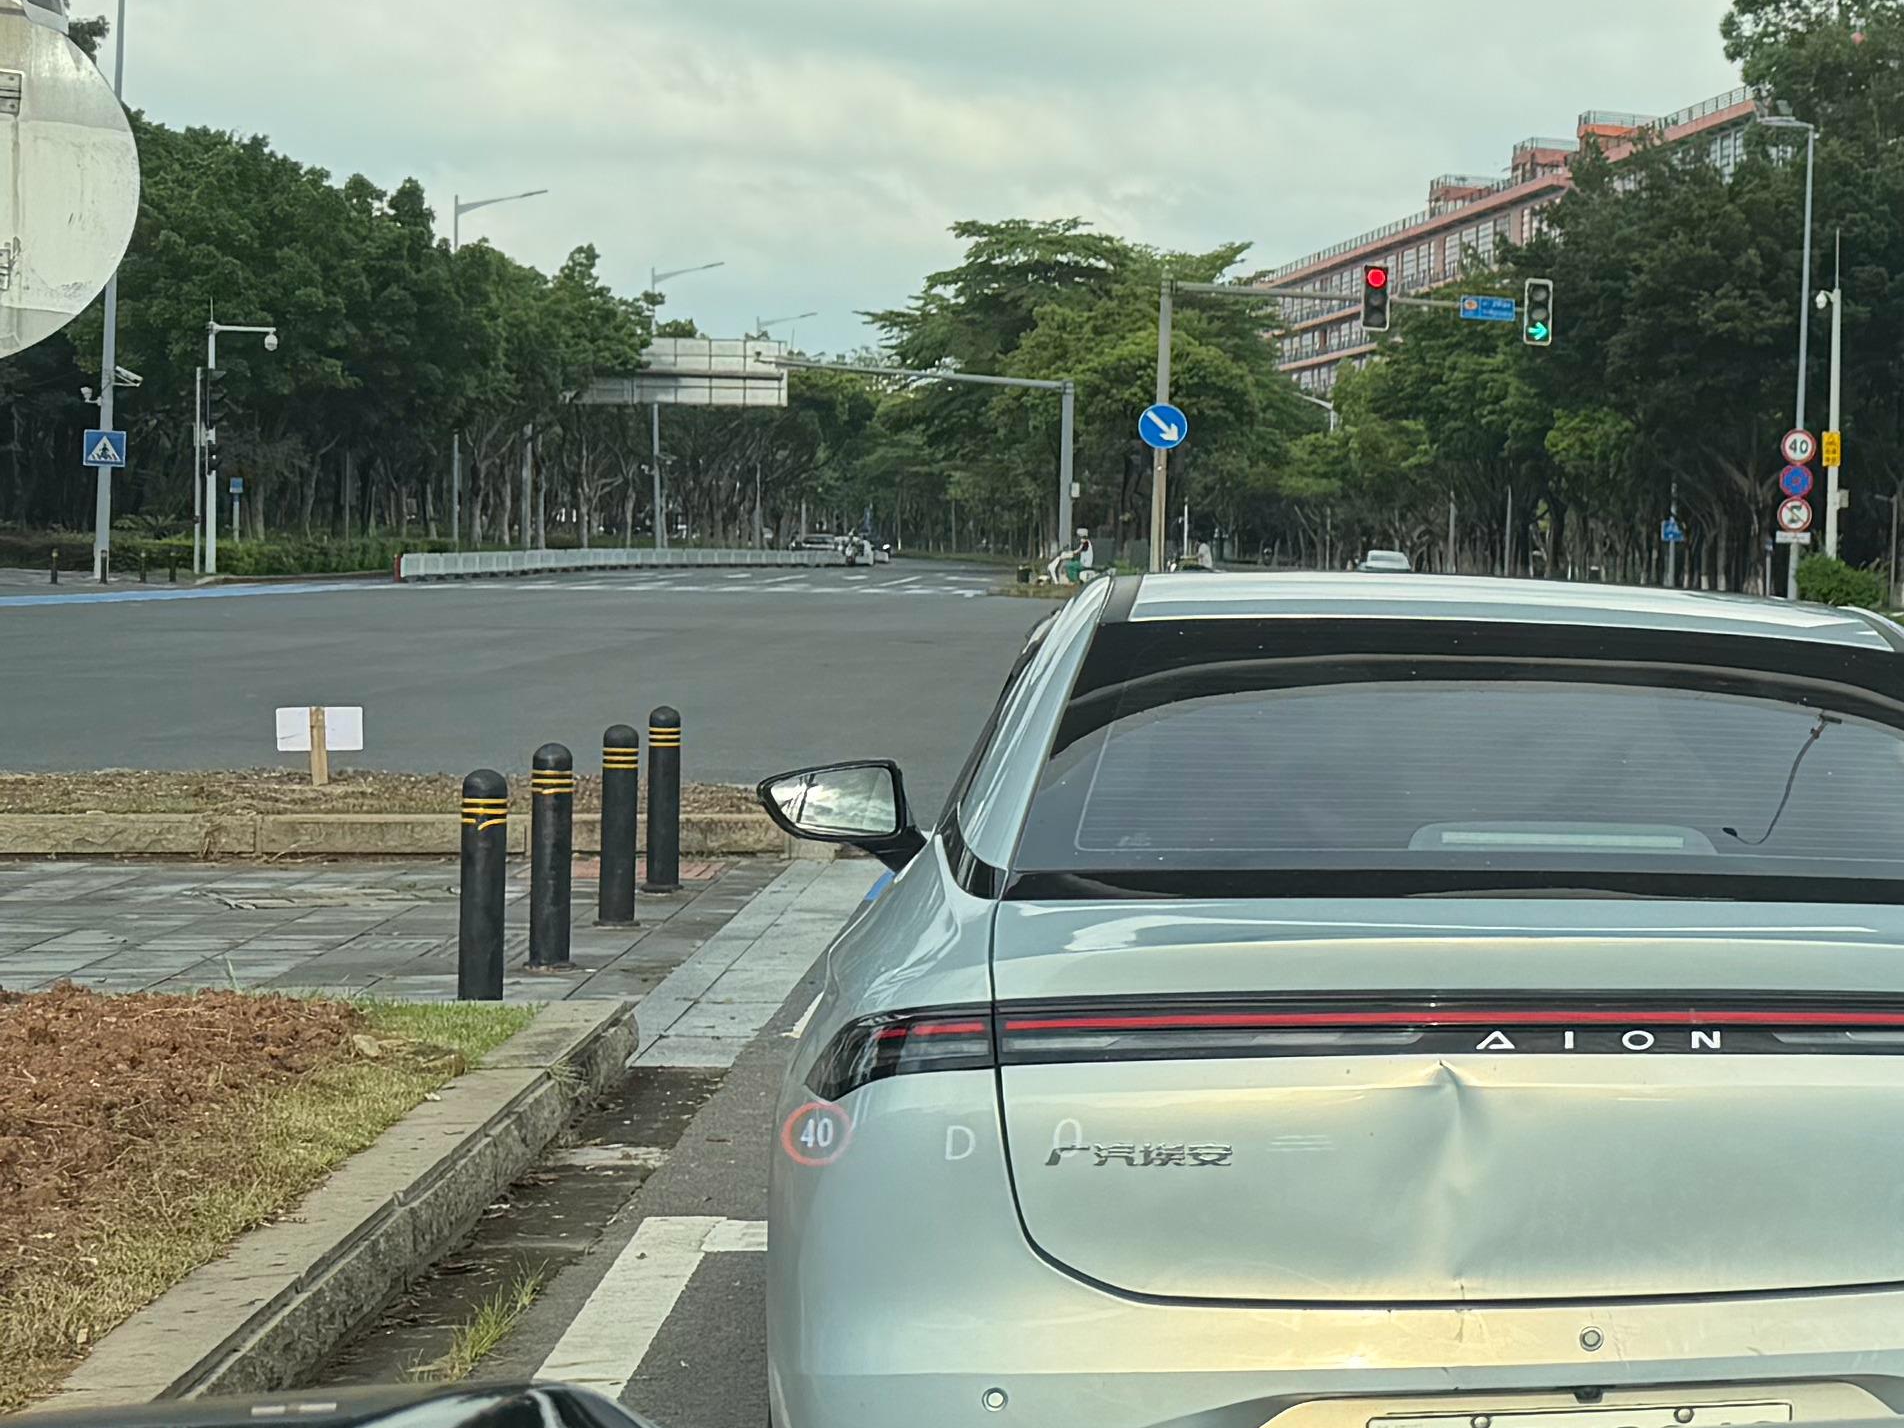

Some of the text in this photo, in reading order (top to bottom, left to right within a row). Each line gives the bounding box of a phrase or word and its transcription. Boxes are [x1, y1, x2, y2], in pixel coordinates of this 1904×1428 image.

[1788, 439, 1809, 454] 40
[1476, 1030, 1721, 1050] AION
[800, 1118, 833, 1147] 40
[945, 1125, 976, 1160] D
[1045, 1143, 1233, 1166] 广汽埃安
